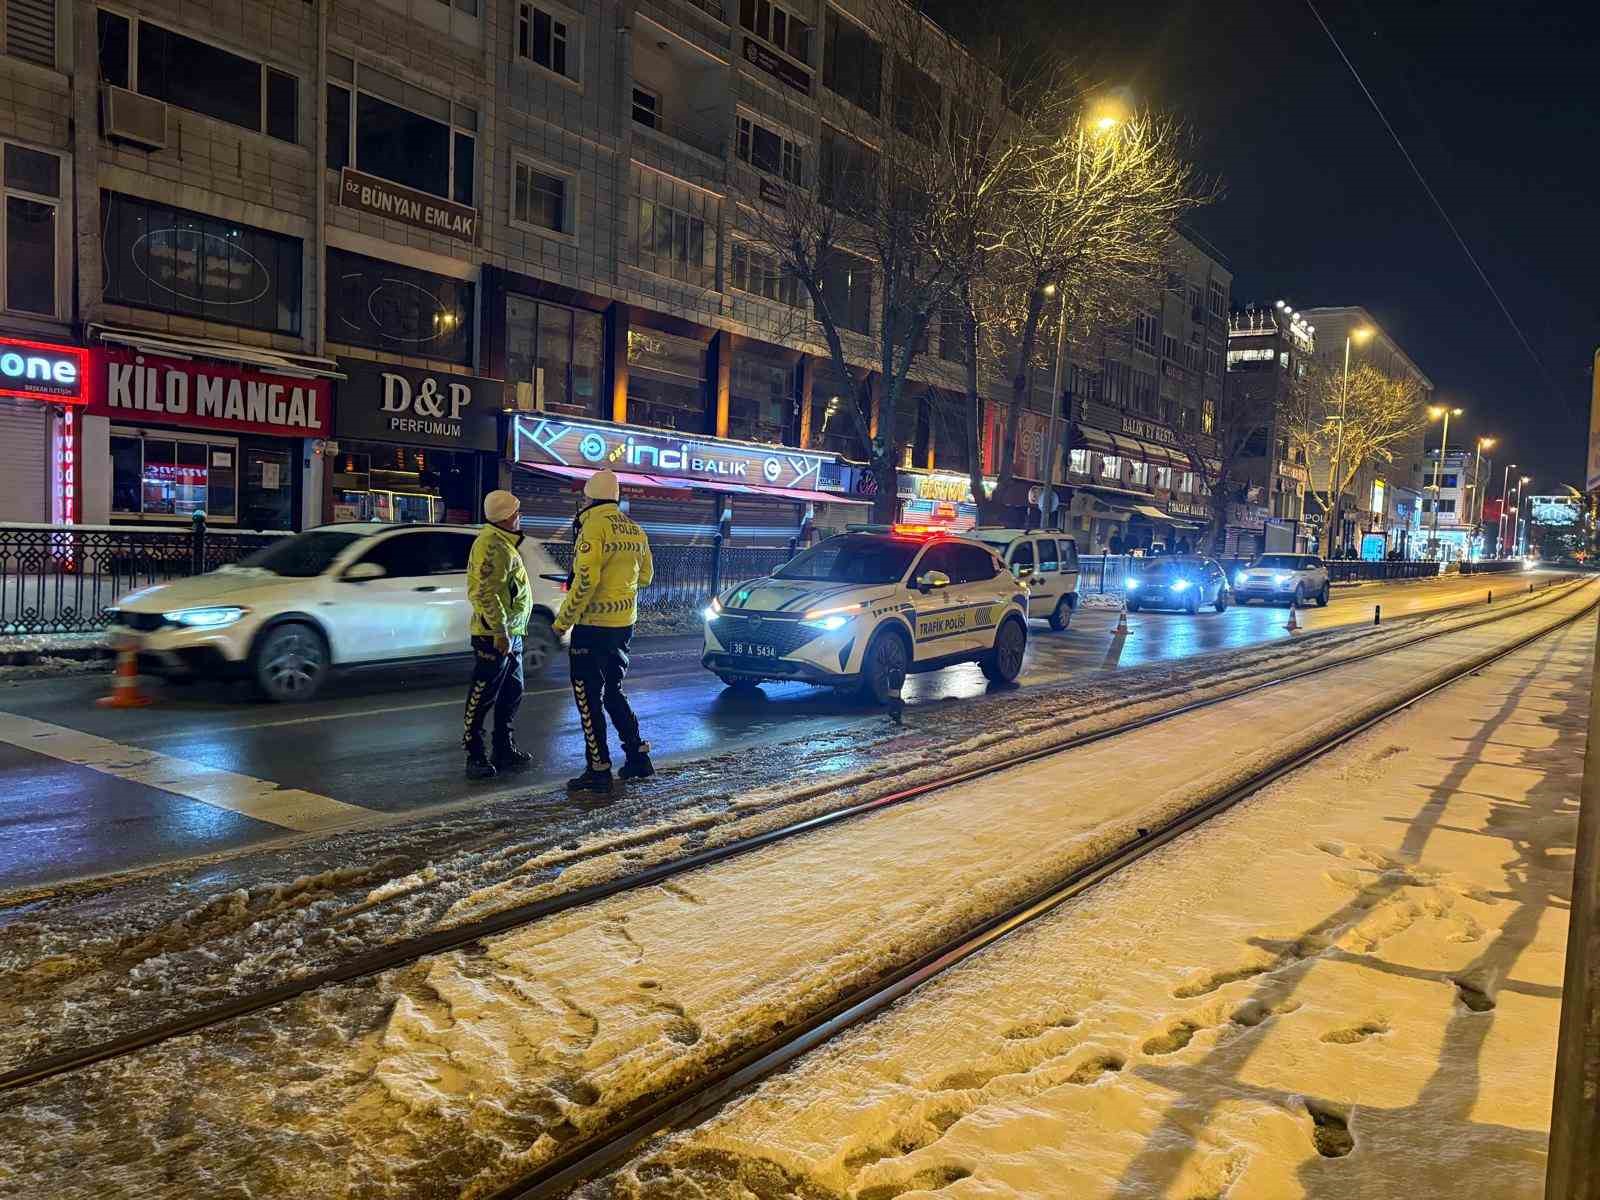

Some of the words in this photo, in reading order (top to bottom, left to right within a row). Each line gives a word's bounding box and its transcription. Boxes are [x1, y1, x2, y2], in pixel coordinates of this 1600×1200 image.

[360, 184, 421, 220] BÜNYAN
[424, 206, 472, 235] EMLAK
[0, 352, 77, 383] one
[108, 356, 189, 414] KİLO
[196, 374, 322, 429] MANGAL
[380, 372, 472, 420] D&P
[391, 417, 461, 437] PERFUMUM
[691, 458, 748, 476] BALIK
[919, 617, 945, 637] TRAFİK
[944, 613, 967, 630] POLİSİ
[734, 643, 743, 654] 38
[747, 644, 753, 655] A
